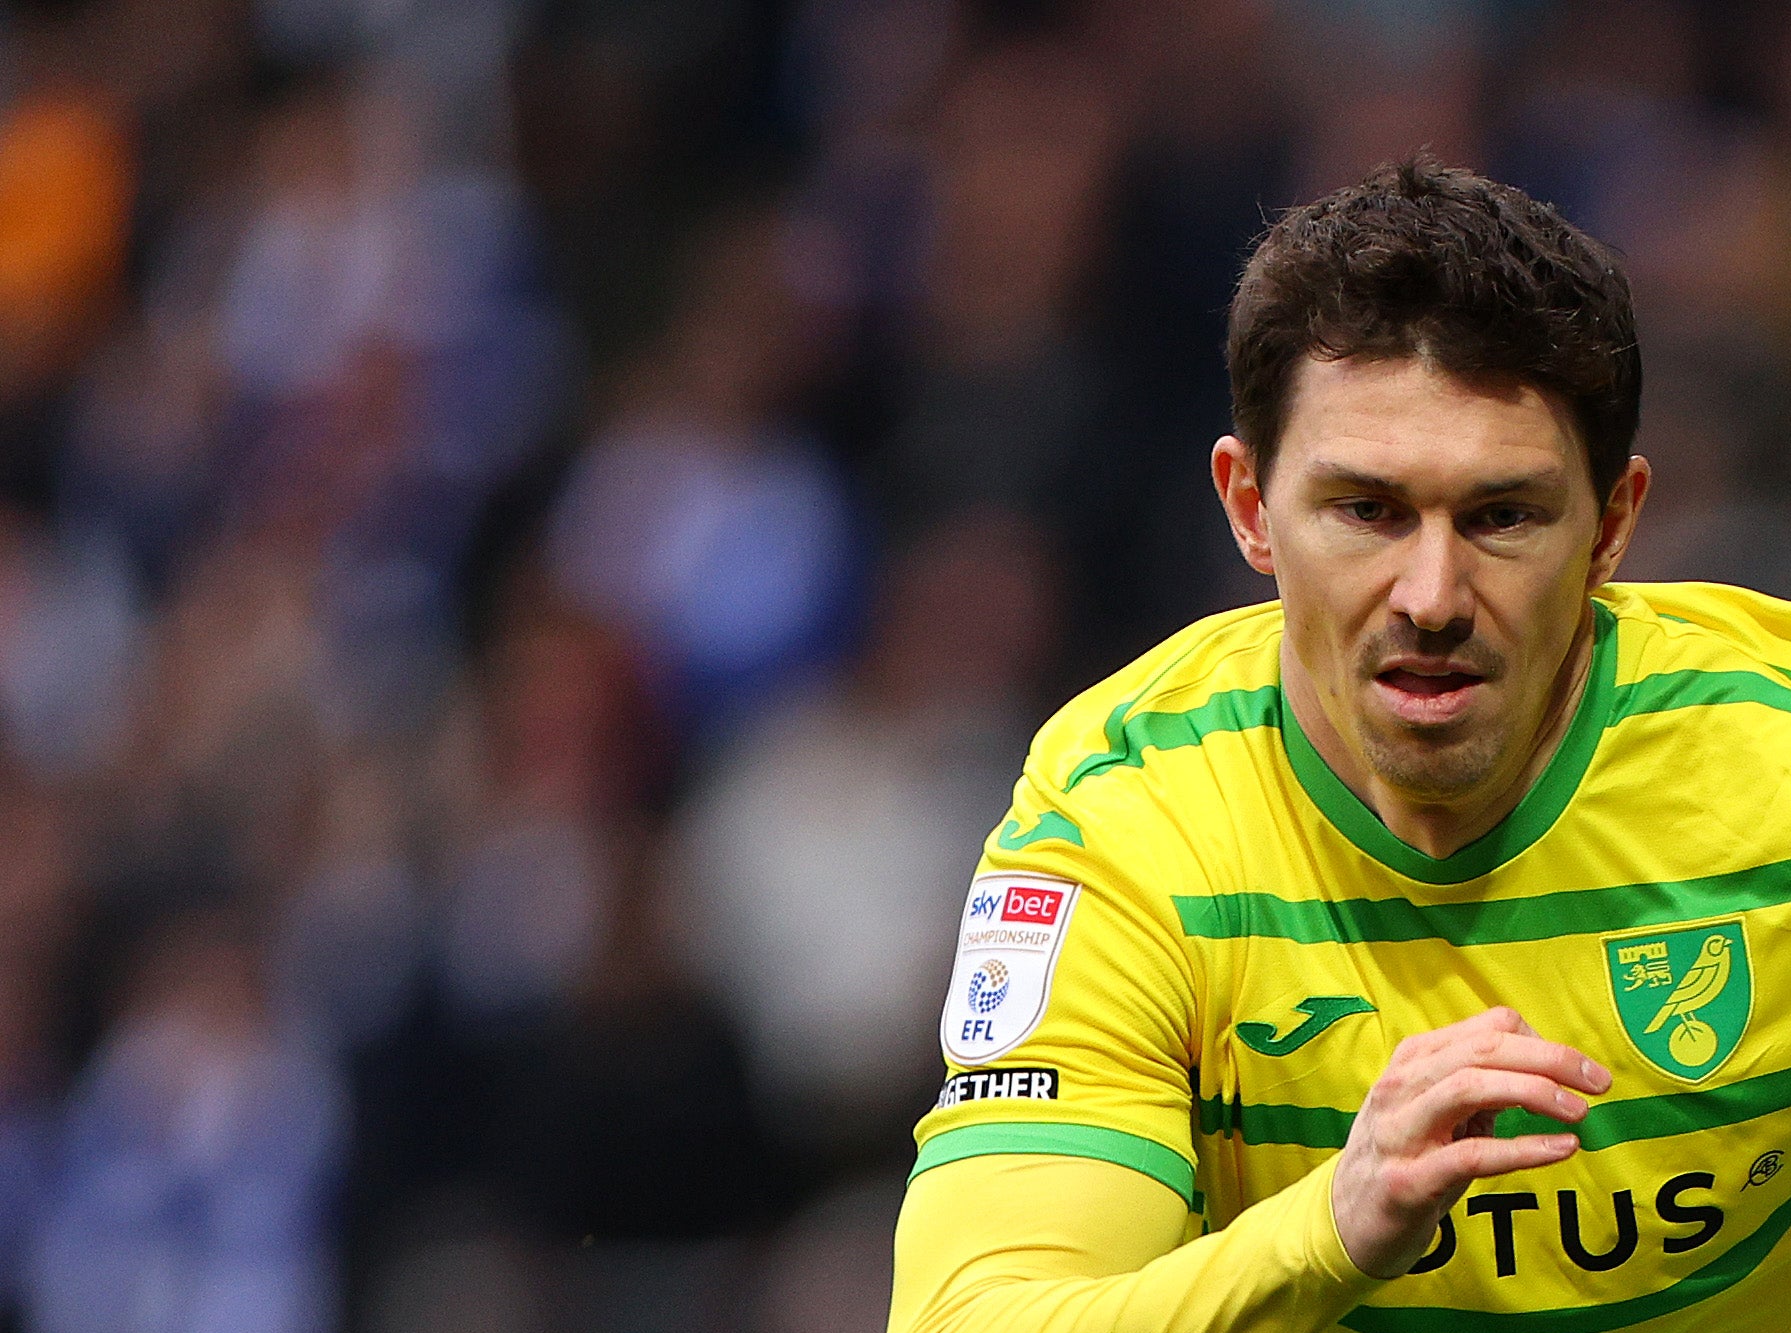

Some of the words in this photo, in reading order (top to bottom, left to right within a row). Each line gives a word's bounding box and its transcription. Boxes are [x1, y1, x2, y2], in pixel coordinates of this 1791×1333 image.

[970, 889, 1002, 920] sky
[1007, 890, 1055, 918] bet
[963, 929, 1051, 947] CHAMPIONSHIP
[961, 1019, 994, 1041] EFL
